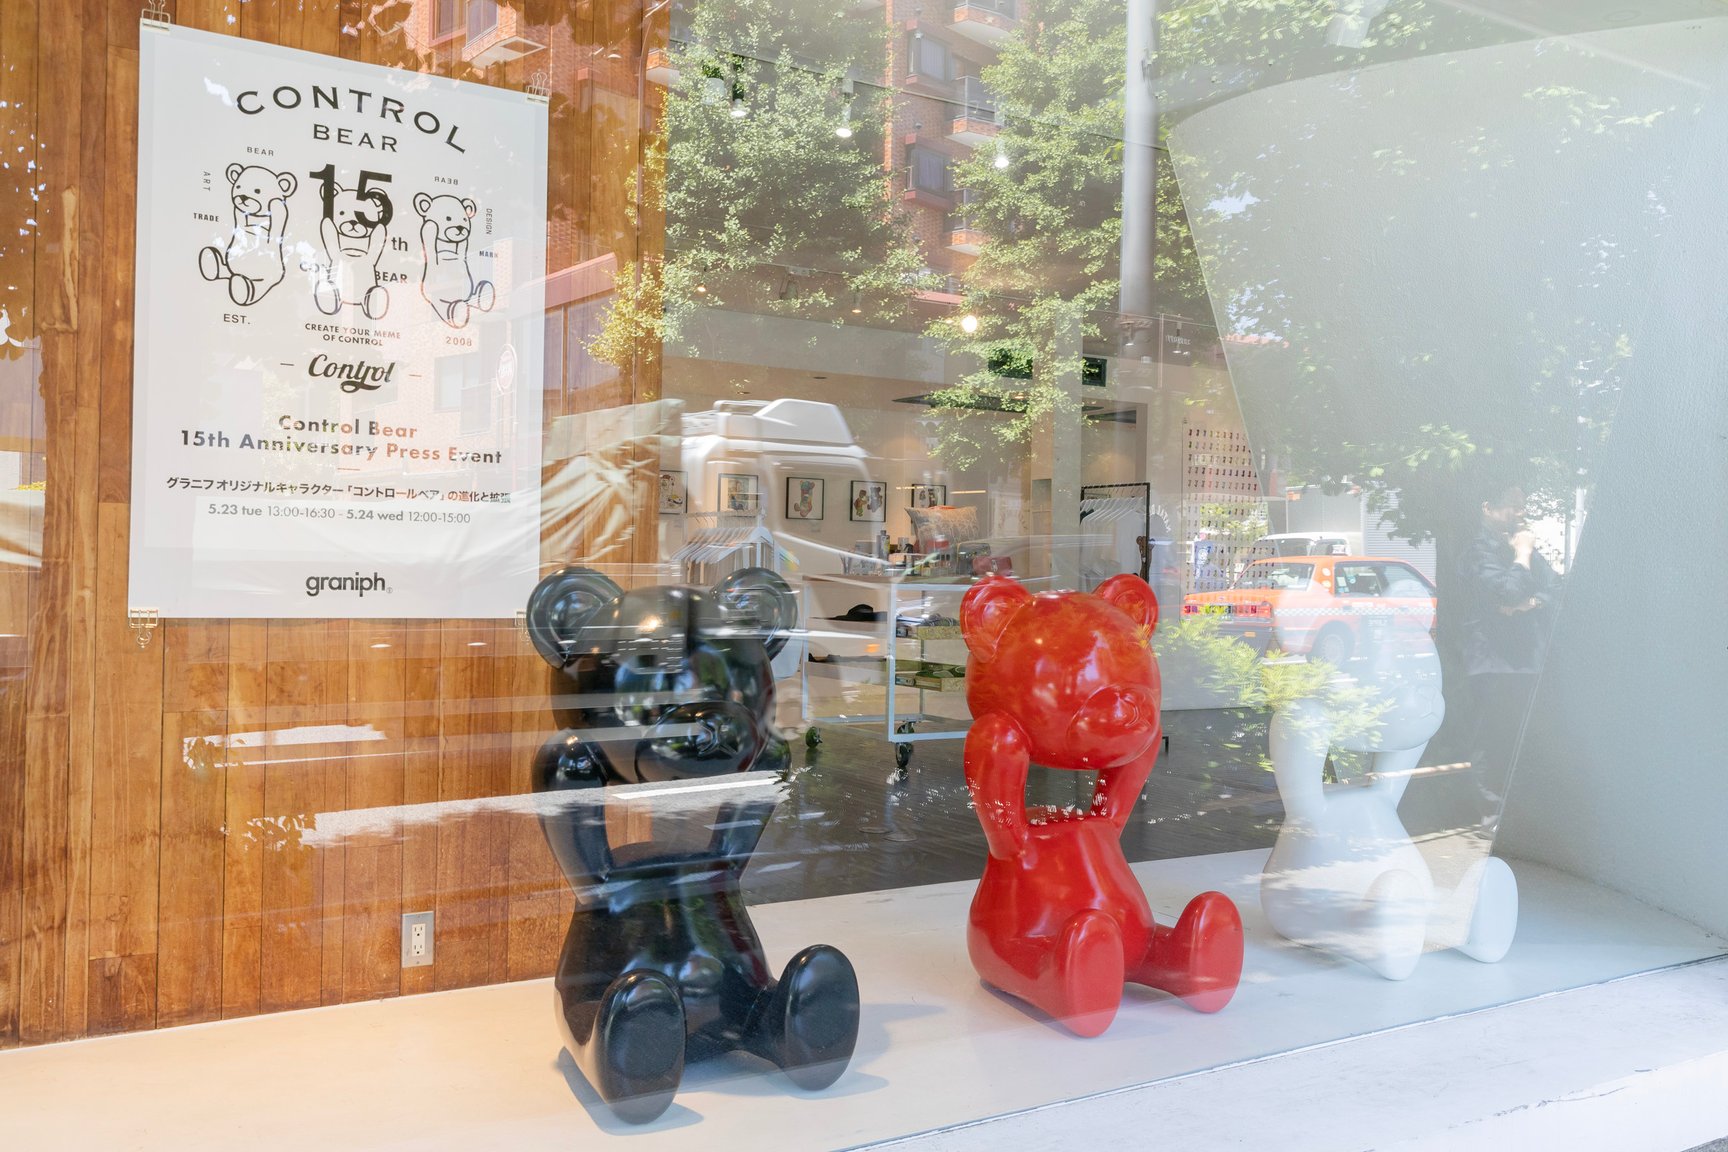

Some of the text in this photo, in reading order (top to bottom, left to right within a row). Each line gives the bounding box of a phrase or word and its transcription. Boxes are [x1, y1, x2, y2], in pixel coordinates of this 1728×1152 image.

[236, 85, 466, 154] CONTROL
[313, 123, 398, 153] BEAR
[246, 146, 275, 157] BEAR
[203, 171, 211, 191] ART
[309, 163, 408, 251] 15 th
[193, 212, 220, 223] TRADE
[485, 208, 493, 235] DESIGN
[375, 271, 408, 284] BEAR
[223, 313, 250, 325] EST.
[305, 323, 401, 339] CREATE YOUR MEME
[323, 333, 383, 346] OF CONTROL
[445, 336, 472, 347] 2008
[308, 353, 396, 394] Control
[278, 414, 418, 439] Control Bear
[181, 429, 502, 464] 15th Anniversary Press Event
[208, 503, 238, 515] 5.23
[241, 505, 262, 517] tue
[267, 505, 335, 519] 13:00-16:30
[346, 509, 374, 521] 5.24
[377, 510, 403, 522] wed
[408, 511, 471, 524] 12:00-15:00
